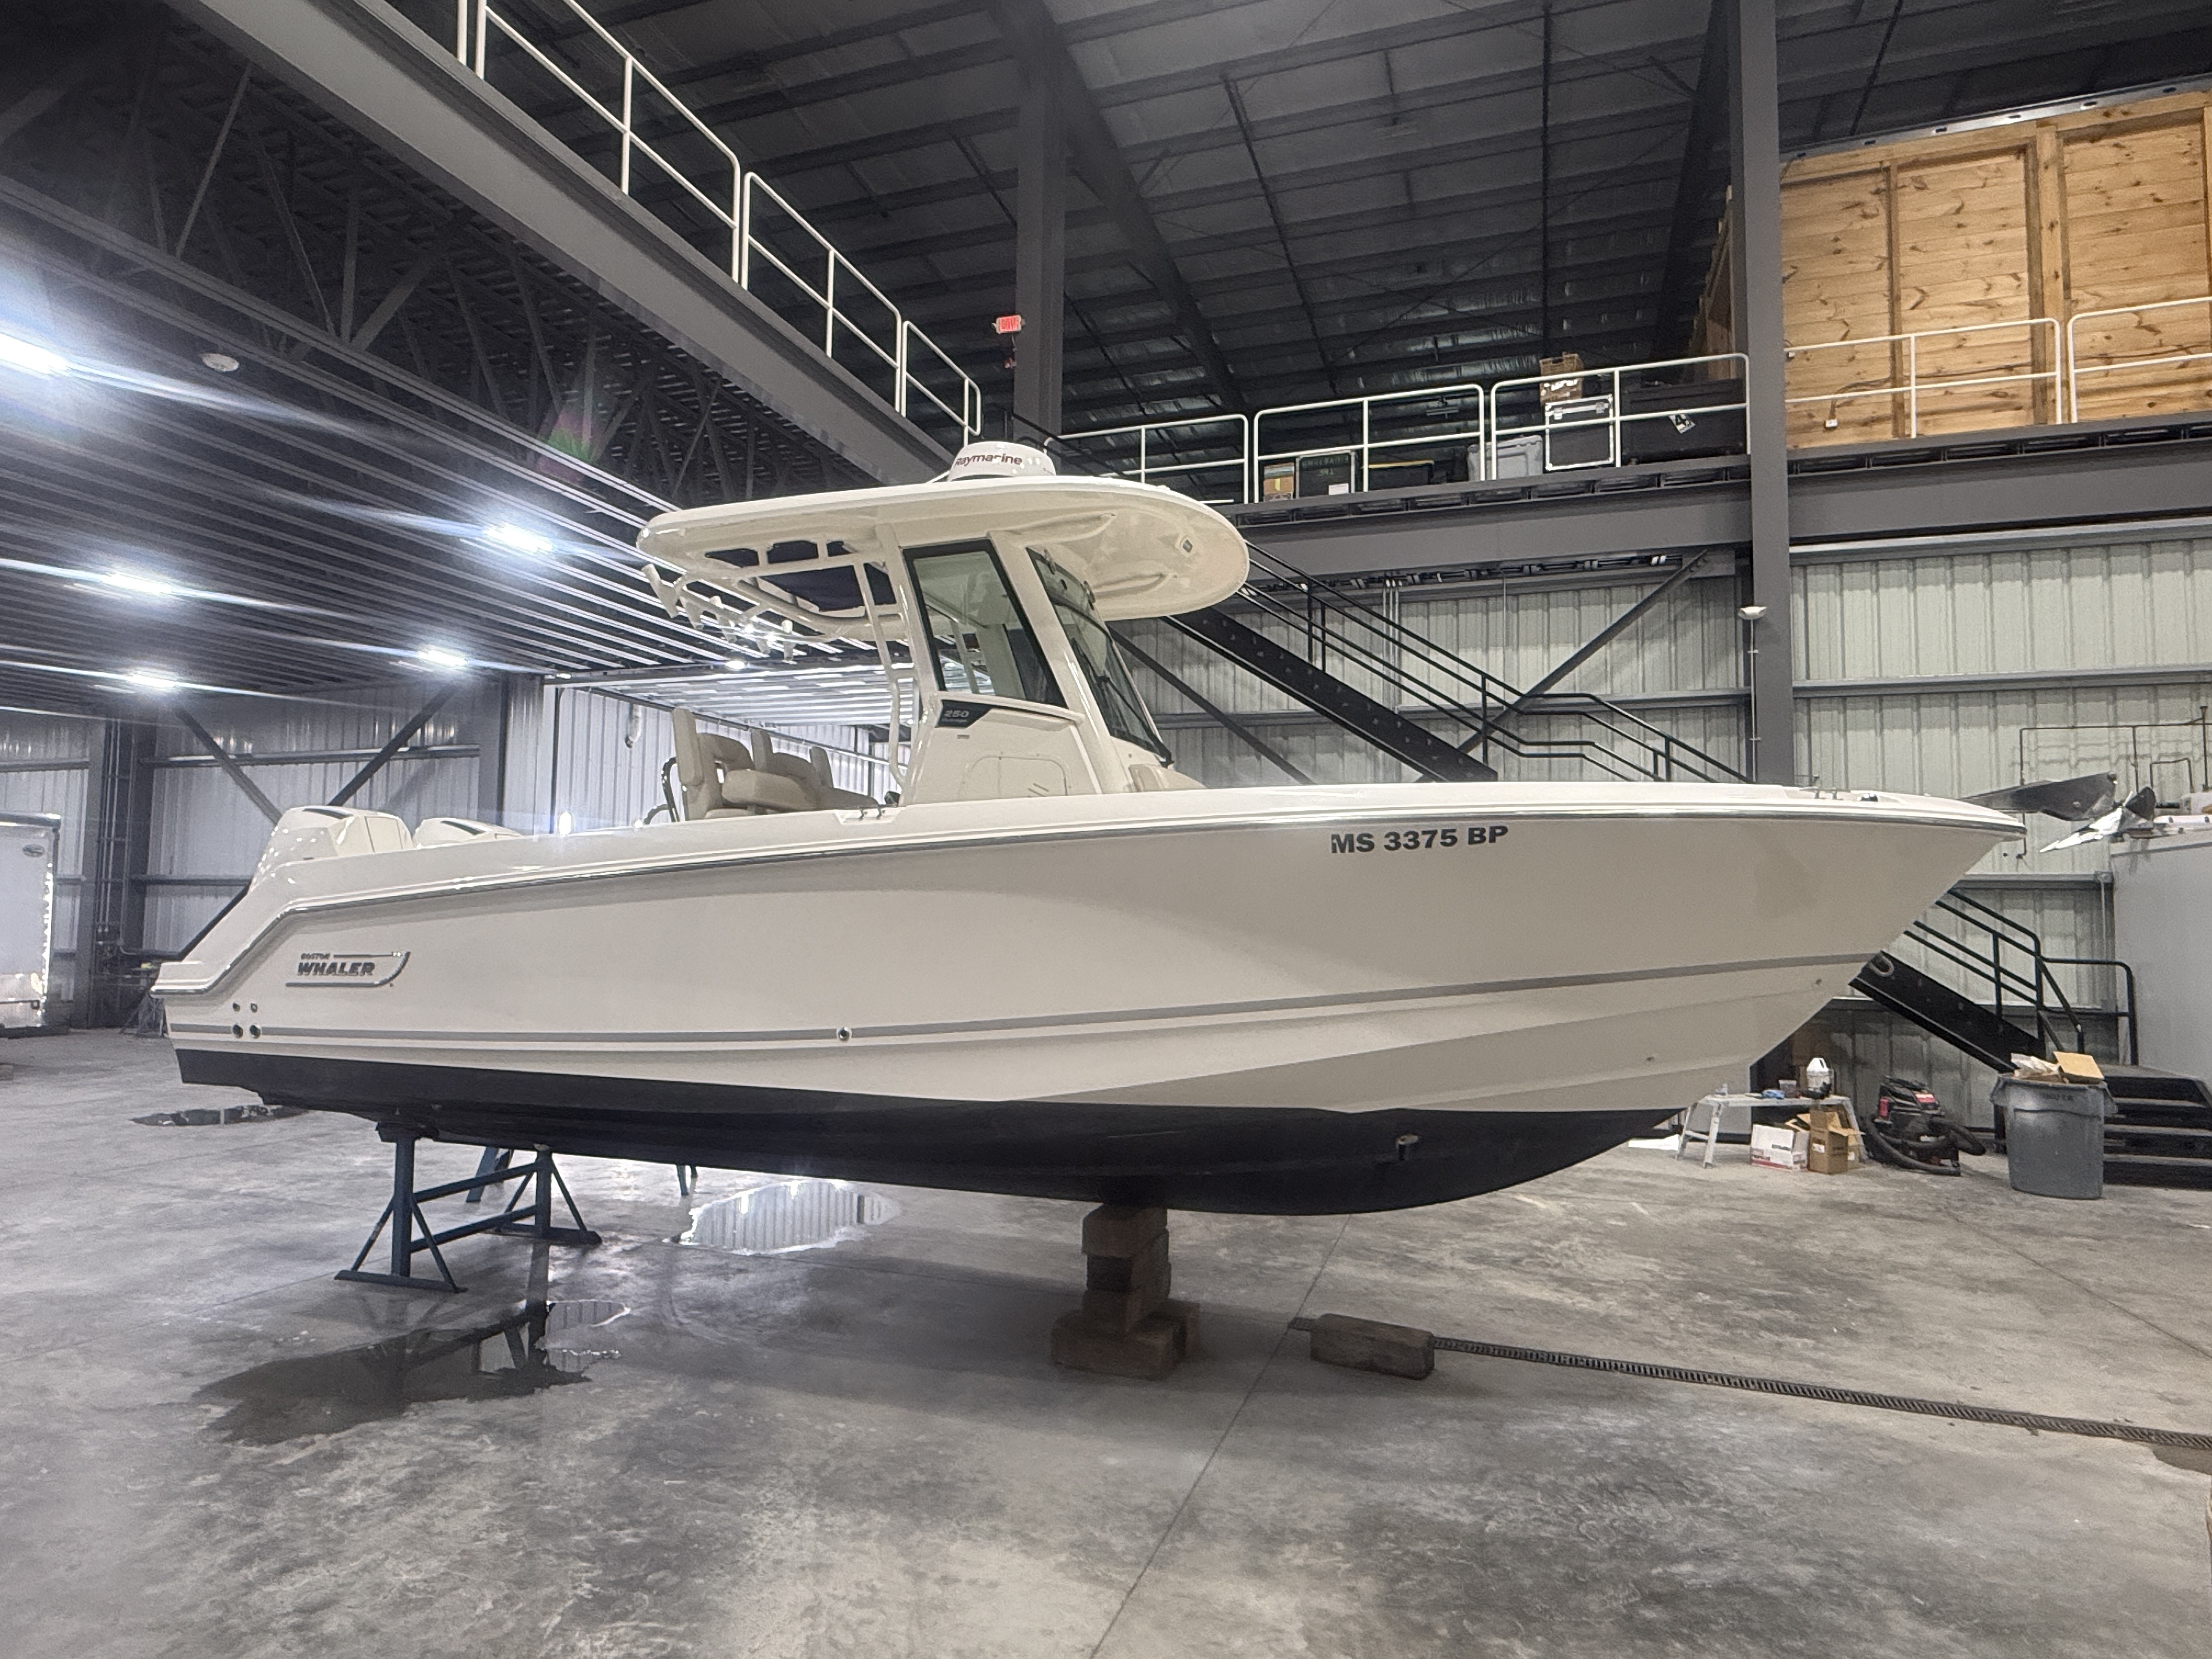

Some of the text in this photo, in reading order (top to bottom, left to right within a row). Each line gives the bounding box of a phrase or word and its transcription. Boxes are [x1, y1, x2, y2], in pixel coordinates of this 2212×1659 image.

[944, 709, 970, 718] 250
[1331, 825, 1509, 854] MS 3375 BP
[297, 962, 375, 976] WHALER
